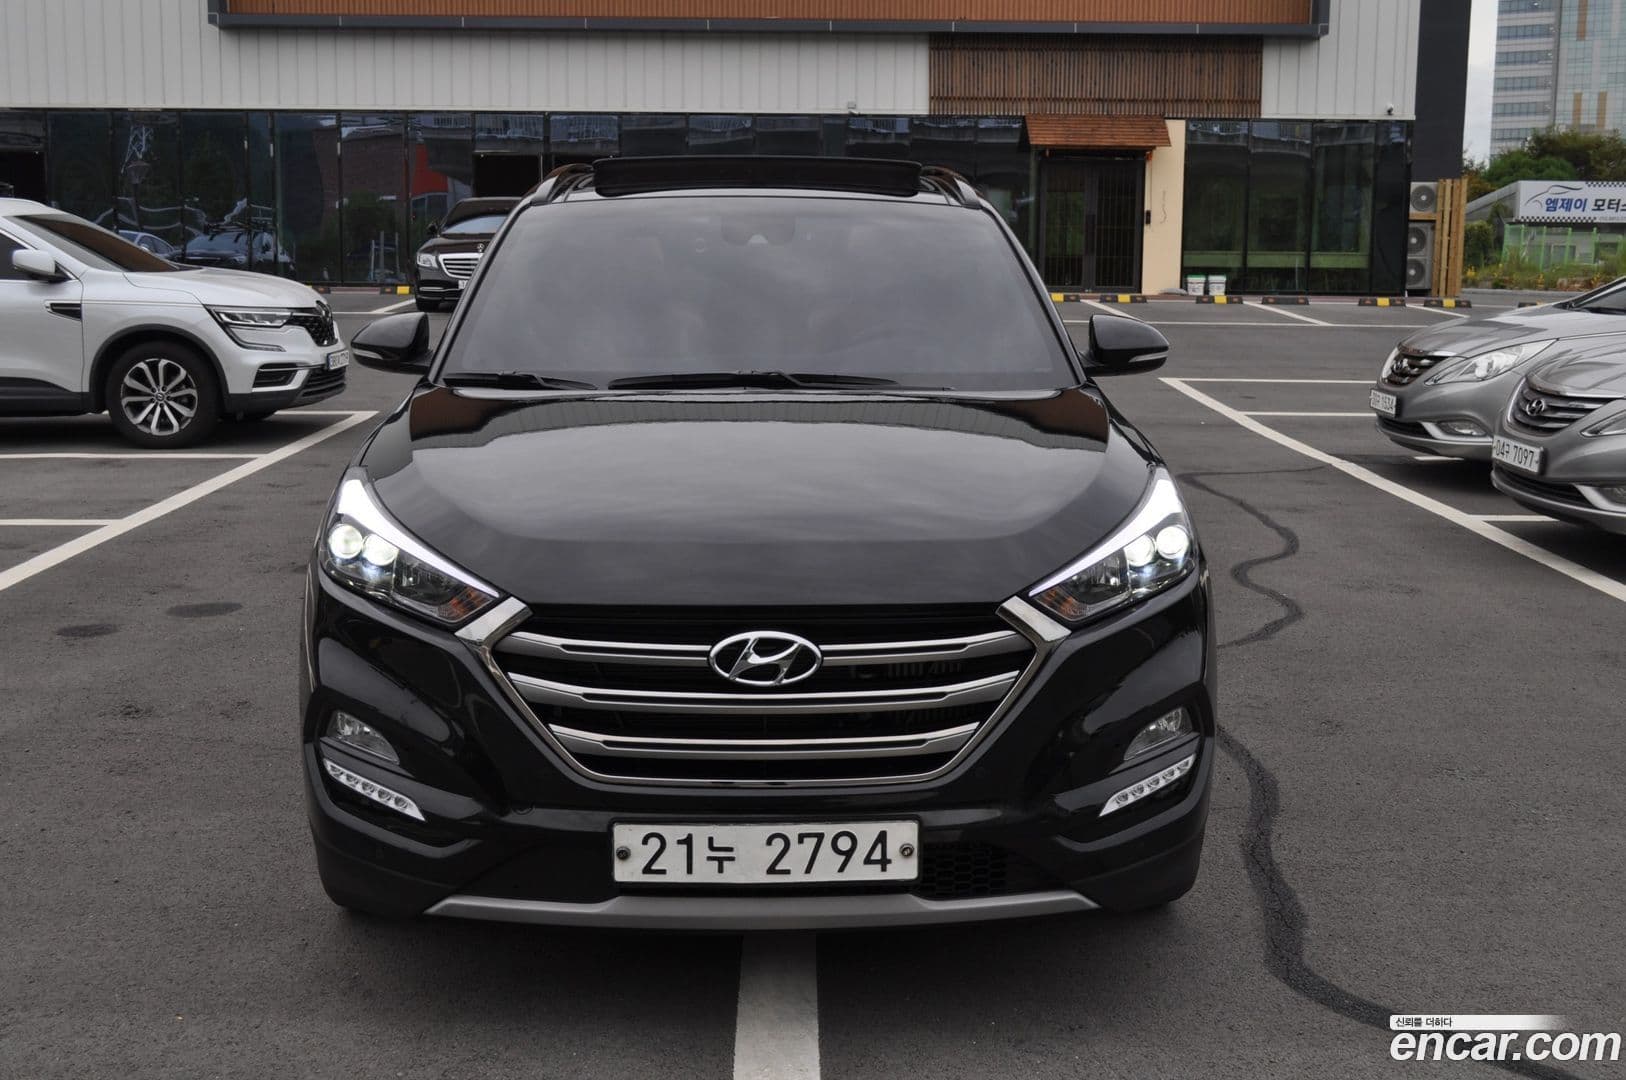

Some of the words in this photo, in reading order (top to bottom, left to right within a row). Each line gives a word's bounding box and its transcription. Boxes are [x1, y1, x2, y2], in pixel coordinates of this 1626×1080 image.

[1545, 198, 1588, 212] 엠제이
[1513, 445, 1535, 466] 7097
[641, 832, 736, 875] 21누
[765, 830, 892, 875] 2794
